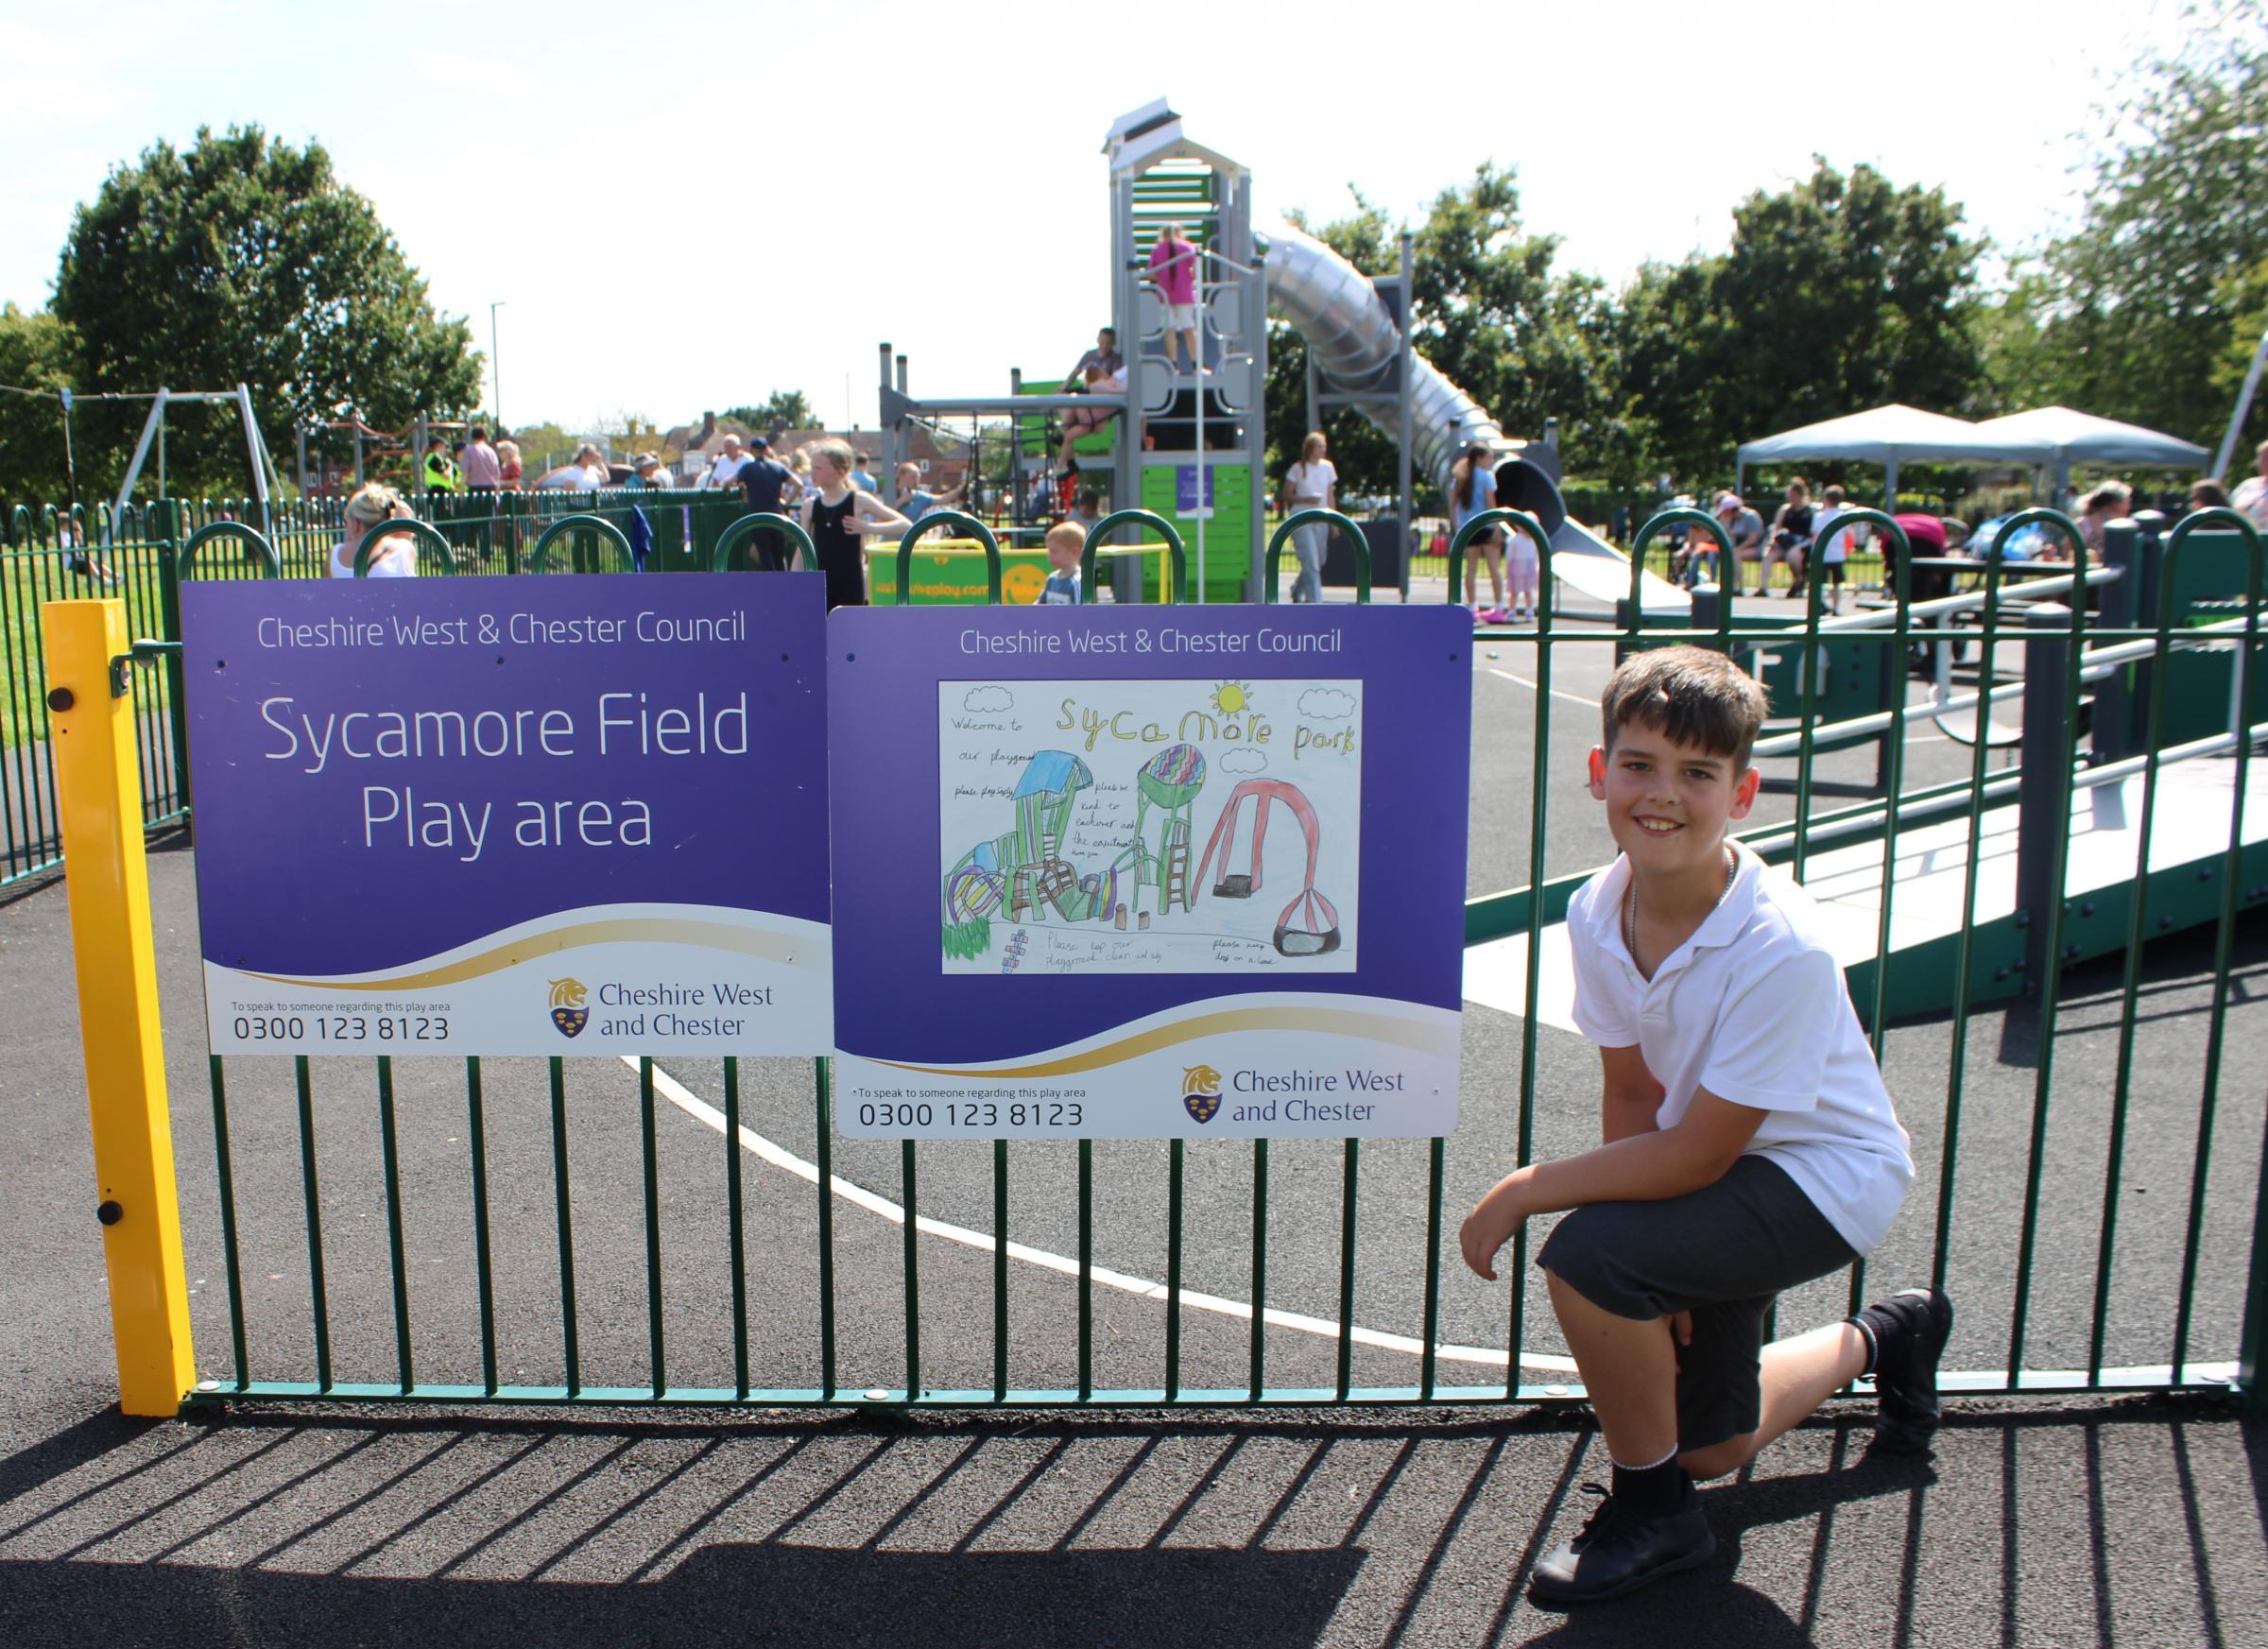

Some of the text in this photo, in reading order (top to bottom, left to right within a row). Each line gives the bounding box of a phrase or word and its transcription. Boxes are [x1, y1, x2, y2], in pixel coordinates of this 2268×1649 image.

[258, 610, 745, 647] Cheshire West & Chester Council
[960, 628, 1341, 654] Cheshire West & Chester Council
[262, 692, 747, 773] Sycamore Field
[951, 717, 1023, 731] Welcome to
[958, 751, 981, 761] our
[1108, 801, 1121, 811] to
[364, 786, 651, 862] Play area
[599, 983, 774, 1005] Cheshire West
[232, 1002, 451, 1014] To speak to someone regarding this play area
[234, 1017, 449, 1039] 0300 123 8123
[600, 1013, 745, 1036] and Chester
[1232, 1070, 1404, 1092] Cheshire West
[858, 1088, 1086, 1099] To speak to someone regarding this play area
[859, 1104, 1083, 1125] 0300 123 8123
[1232, 1099, 1375, 1122] and Chester
